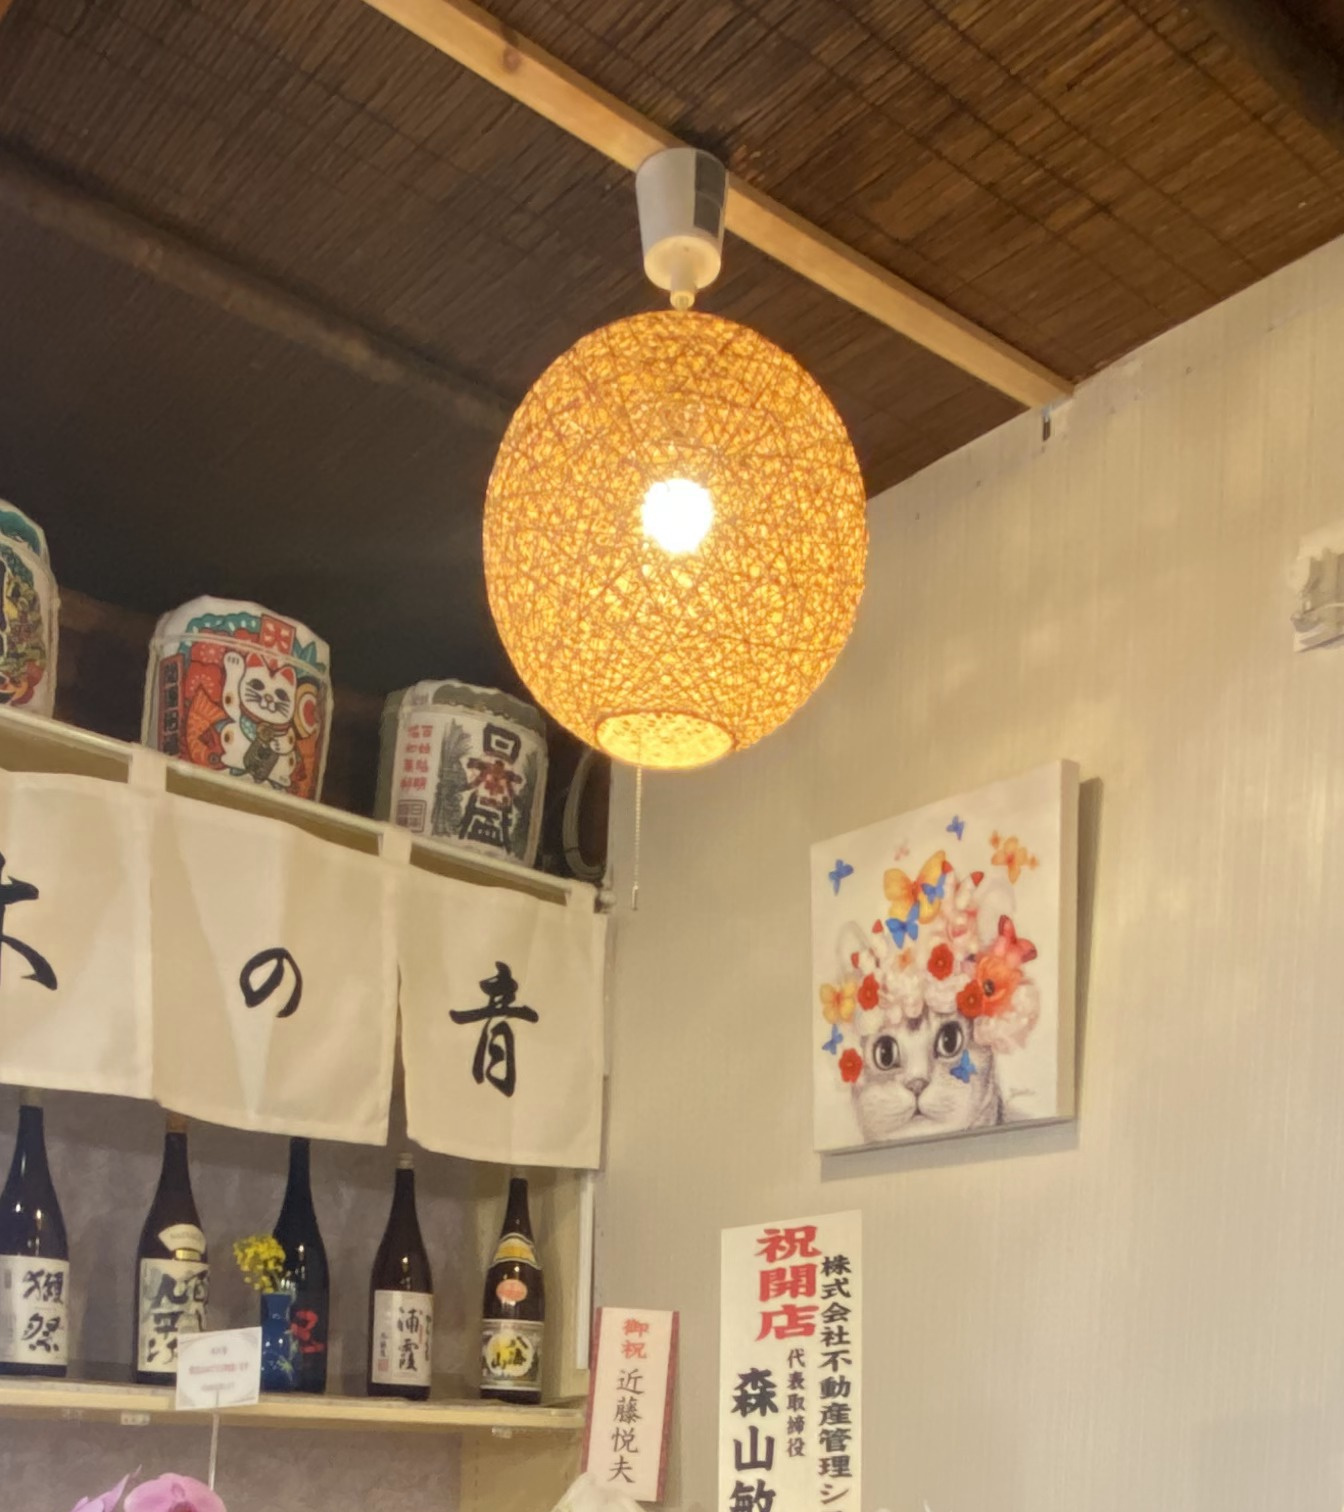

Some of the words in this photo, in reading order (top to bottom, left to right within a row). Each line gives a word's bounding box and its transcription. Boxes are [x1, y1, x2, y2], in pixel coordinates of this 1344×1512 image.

[458, 722, 524, 853] 日本盛
[621, 1318, 649, 1360] 御祝
[755, 1225, 823, 1342] 祝開店
[607, 1368, 644, 1484] 近藤悦夫
[786, 1348, 806, 1458] 代表取締役
